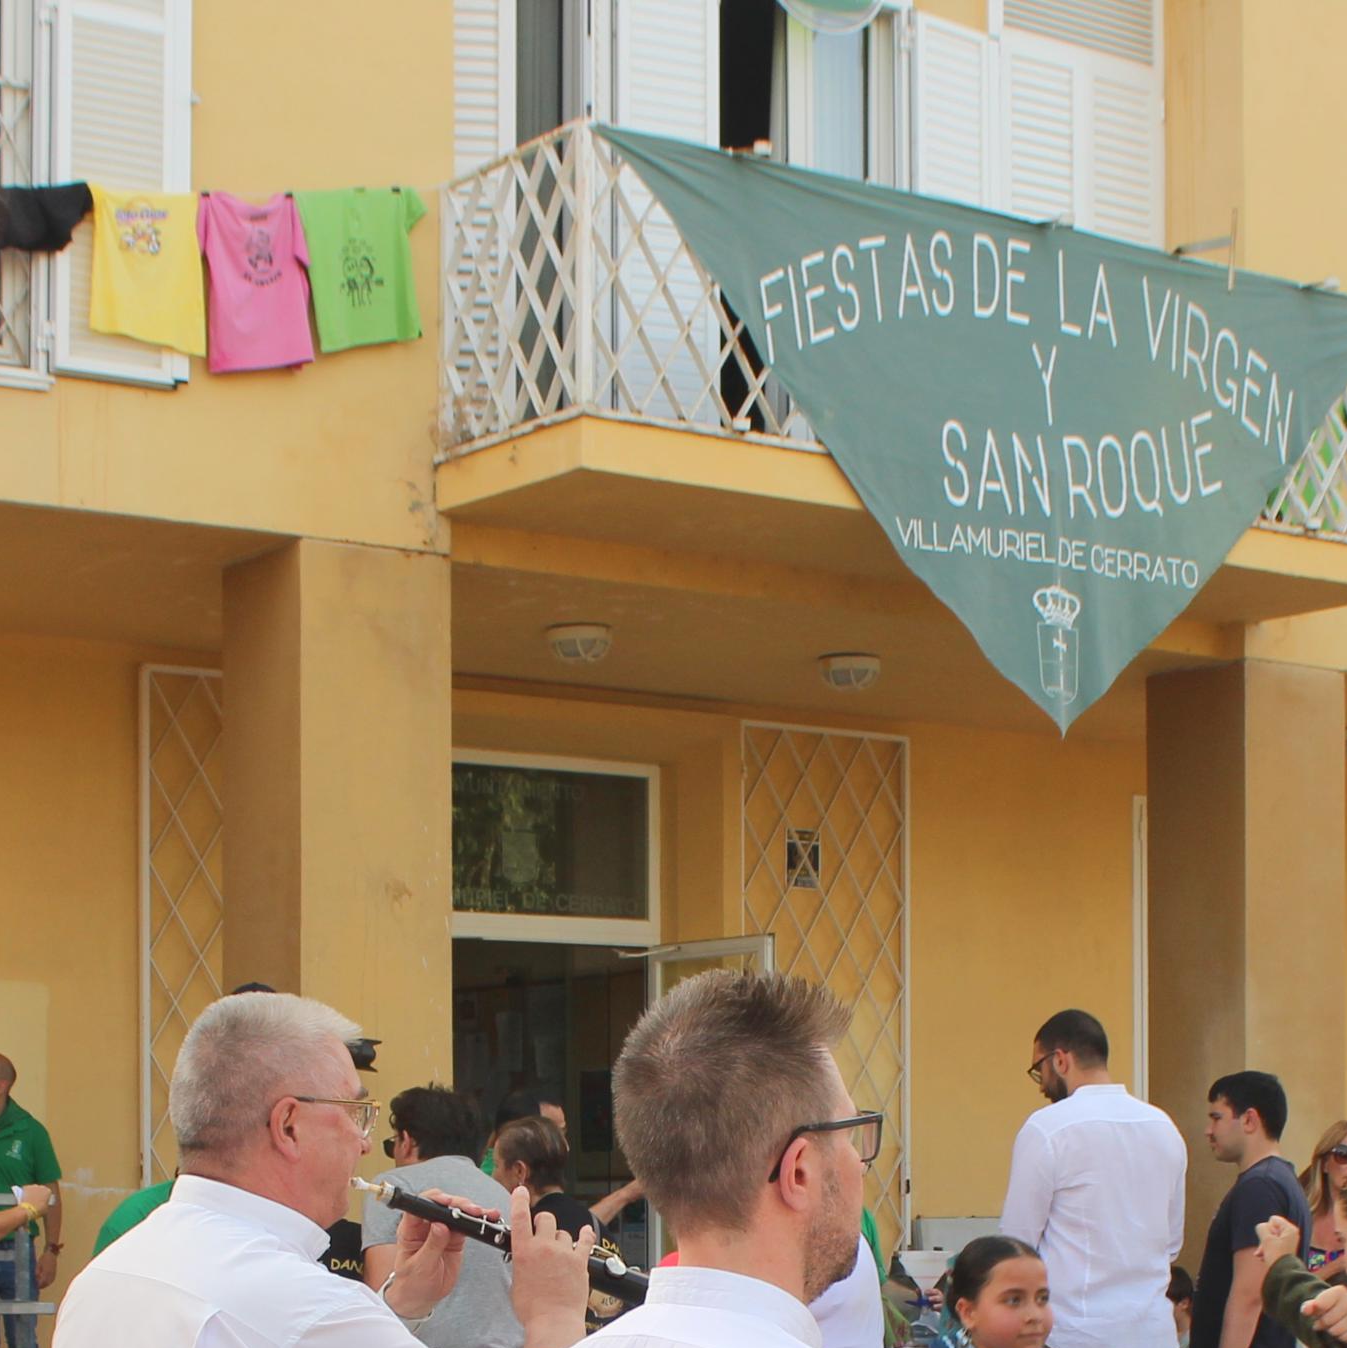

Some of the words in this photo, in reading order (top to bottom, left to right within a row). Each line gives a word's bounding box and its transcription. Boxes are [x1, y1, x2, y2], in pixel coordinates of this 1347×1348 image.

[760, 231, 955, 365] FIESTAS
[972, 233, 1033, 325] DE
[1058, 249, 1118, 347] LA
[1141, 276, 1295, 464] VIRGEN
[1031, 342, 1057, 426] Y
[941, 420, 1051, 518] SAN
[1062, 410, 1223, 520] ROQUE
[895, 516, 1058, 566] VILLAMURIEL
[1059, 536, 1087, 571] DE
[1090, 546, 1199, 590] CERRATO
[521, 892, 548, 910] DE
[555, 893, 639, 914] CERRATO
[330, 1258, 364, 1274] DAN
